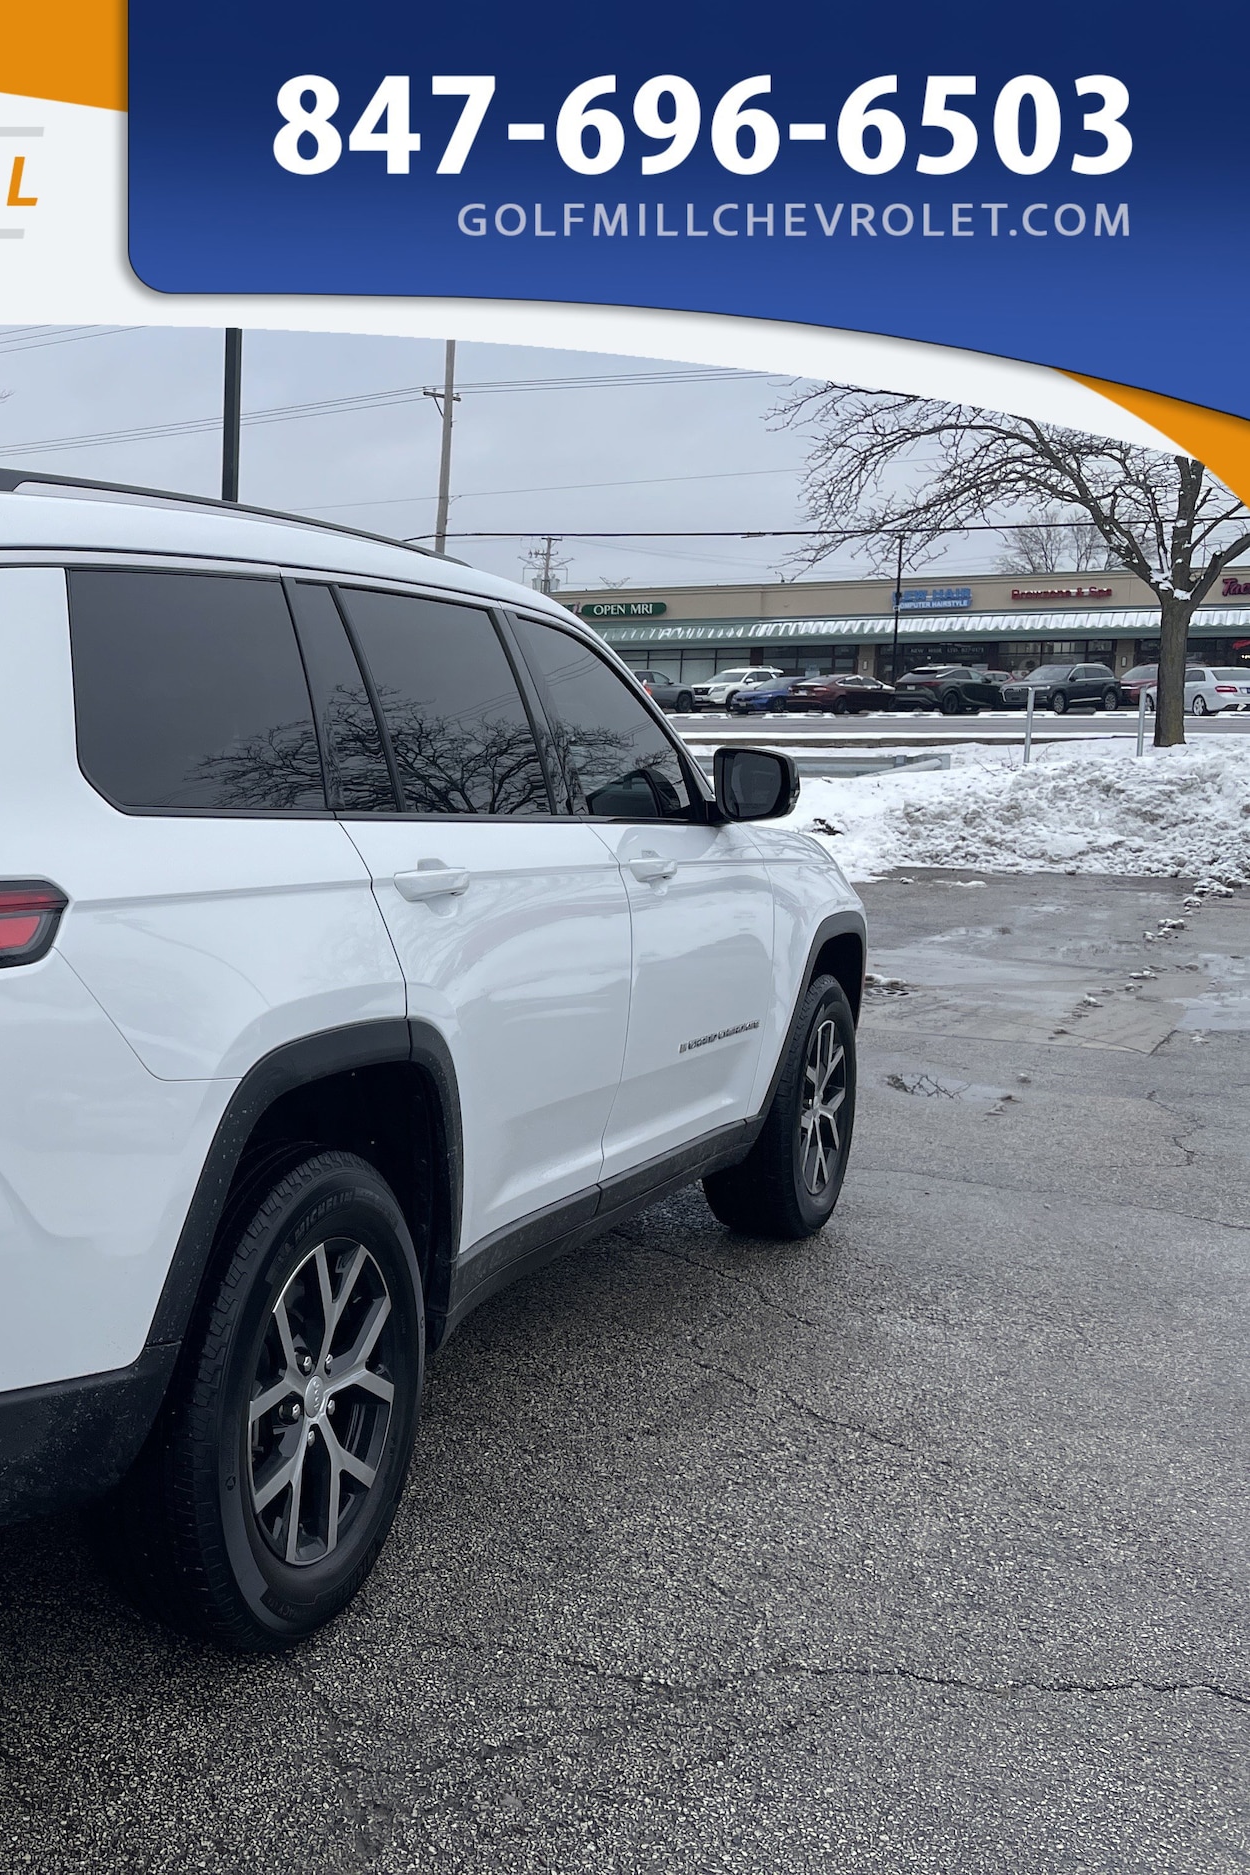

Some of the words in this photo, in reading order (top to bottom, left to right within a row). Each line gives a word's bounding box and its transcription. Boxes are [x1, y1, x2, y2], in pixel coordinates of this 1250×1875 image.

[593, 604, 626, 616] OPEN
[630, 603, 653, 615] MRI
[897, 601, 930, 609] OMPUTER
[932, 600, 968, 608] HAIRSTYLE
